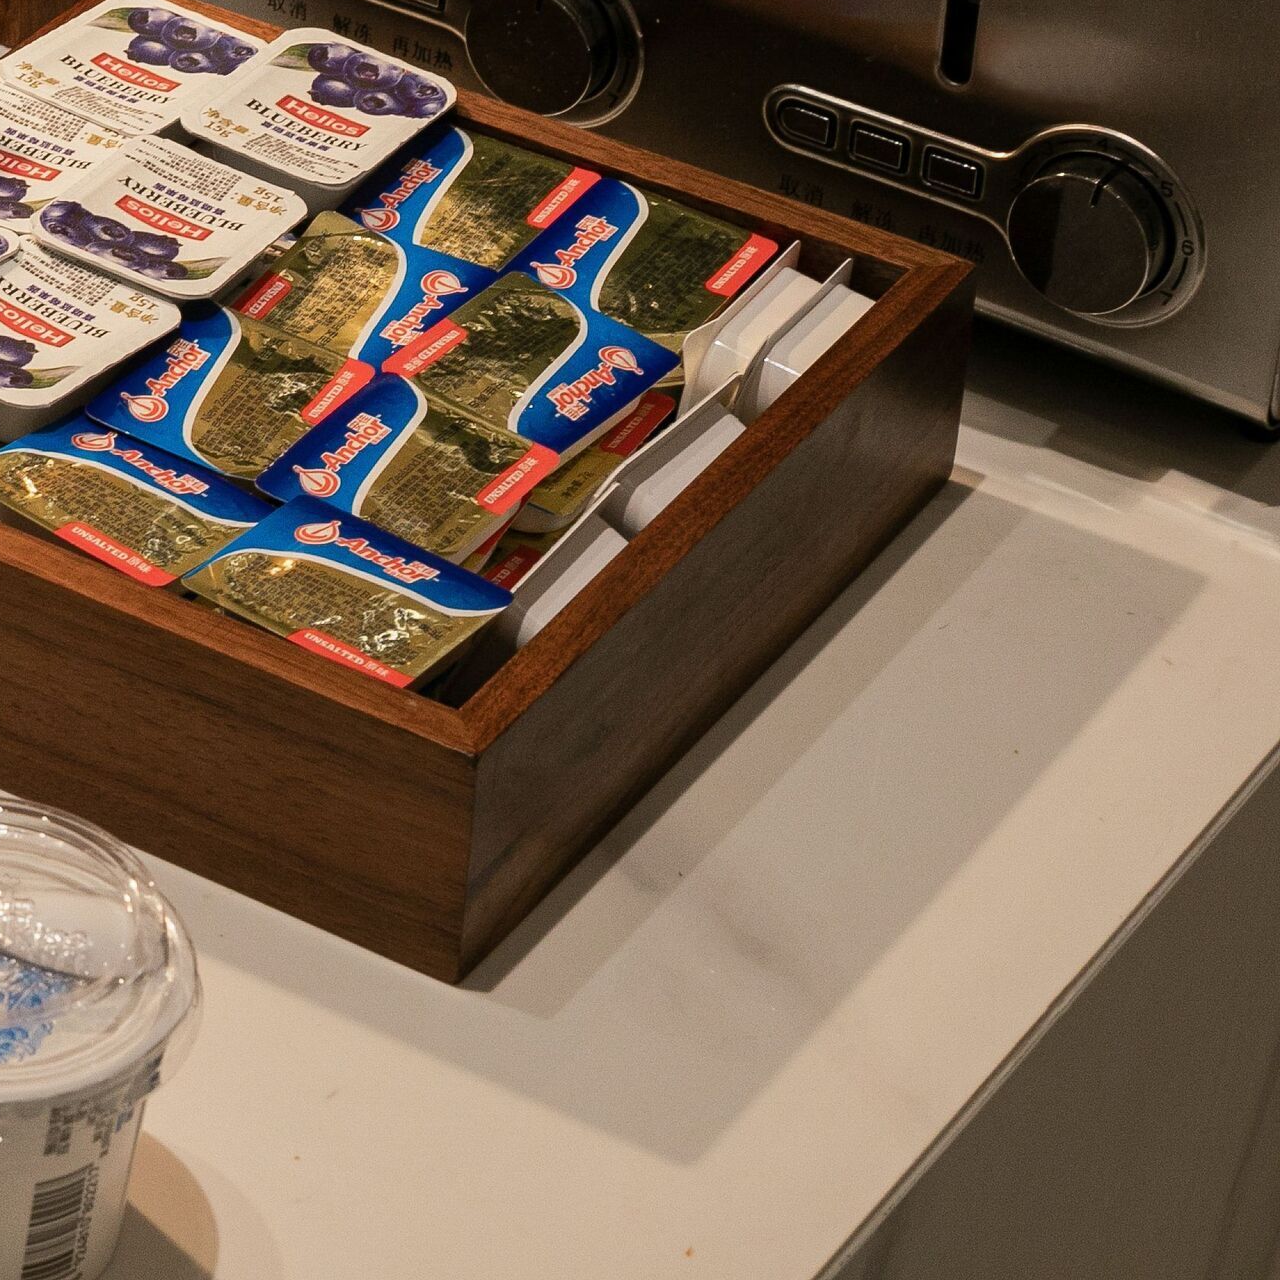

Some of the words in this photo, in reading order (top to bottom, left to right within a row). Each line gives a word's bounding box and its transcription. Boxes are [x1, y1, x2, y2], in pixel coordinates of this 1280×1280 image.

[391, 35, 454, 70] 再加热
[59, 54, 175, 104] BLUEBERRY
[100, 57, 171, 91] Helios
[244, 98, 369, 152] BLUEBERRY
[284, 98, 361, 137] Helios
[115, 175, 247, 232] BLUEBERRY
[379, 163, 438, 209] Anchor
[533, 188, 569, 224] UNSALTED
[778, 173, 825, 206] 取消
[1159, 180, 1175, 199] 5
[126, 197, 203, 240] Helios
[555, 218, 611, 266] Anchor
[1181, 239, 1195, 257] 6
[711, 255, 748, 290] UNSALTED
[387, 294, 443, 345] Anchor
[147, 345, 206, 396] Anchor
[554, 364, 617, 411] Anchor
[308, 382, 346, 419] UNSALTED
[322, 420, 384, 471] Anchor
[116, 447, 197, 496] Anchor
[484, 470, 523, 505] UNSALTED
[71, 526, 127, 561] UNSALTED
[342, 537, 428, 583] Anchor
[303, 632, 364, 665] UNSALTED
